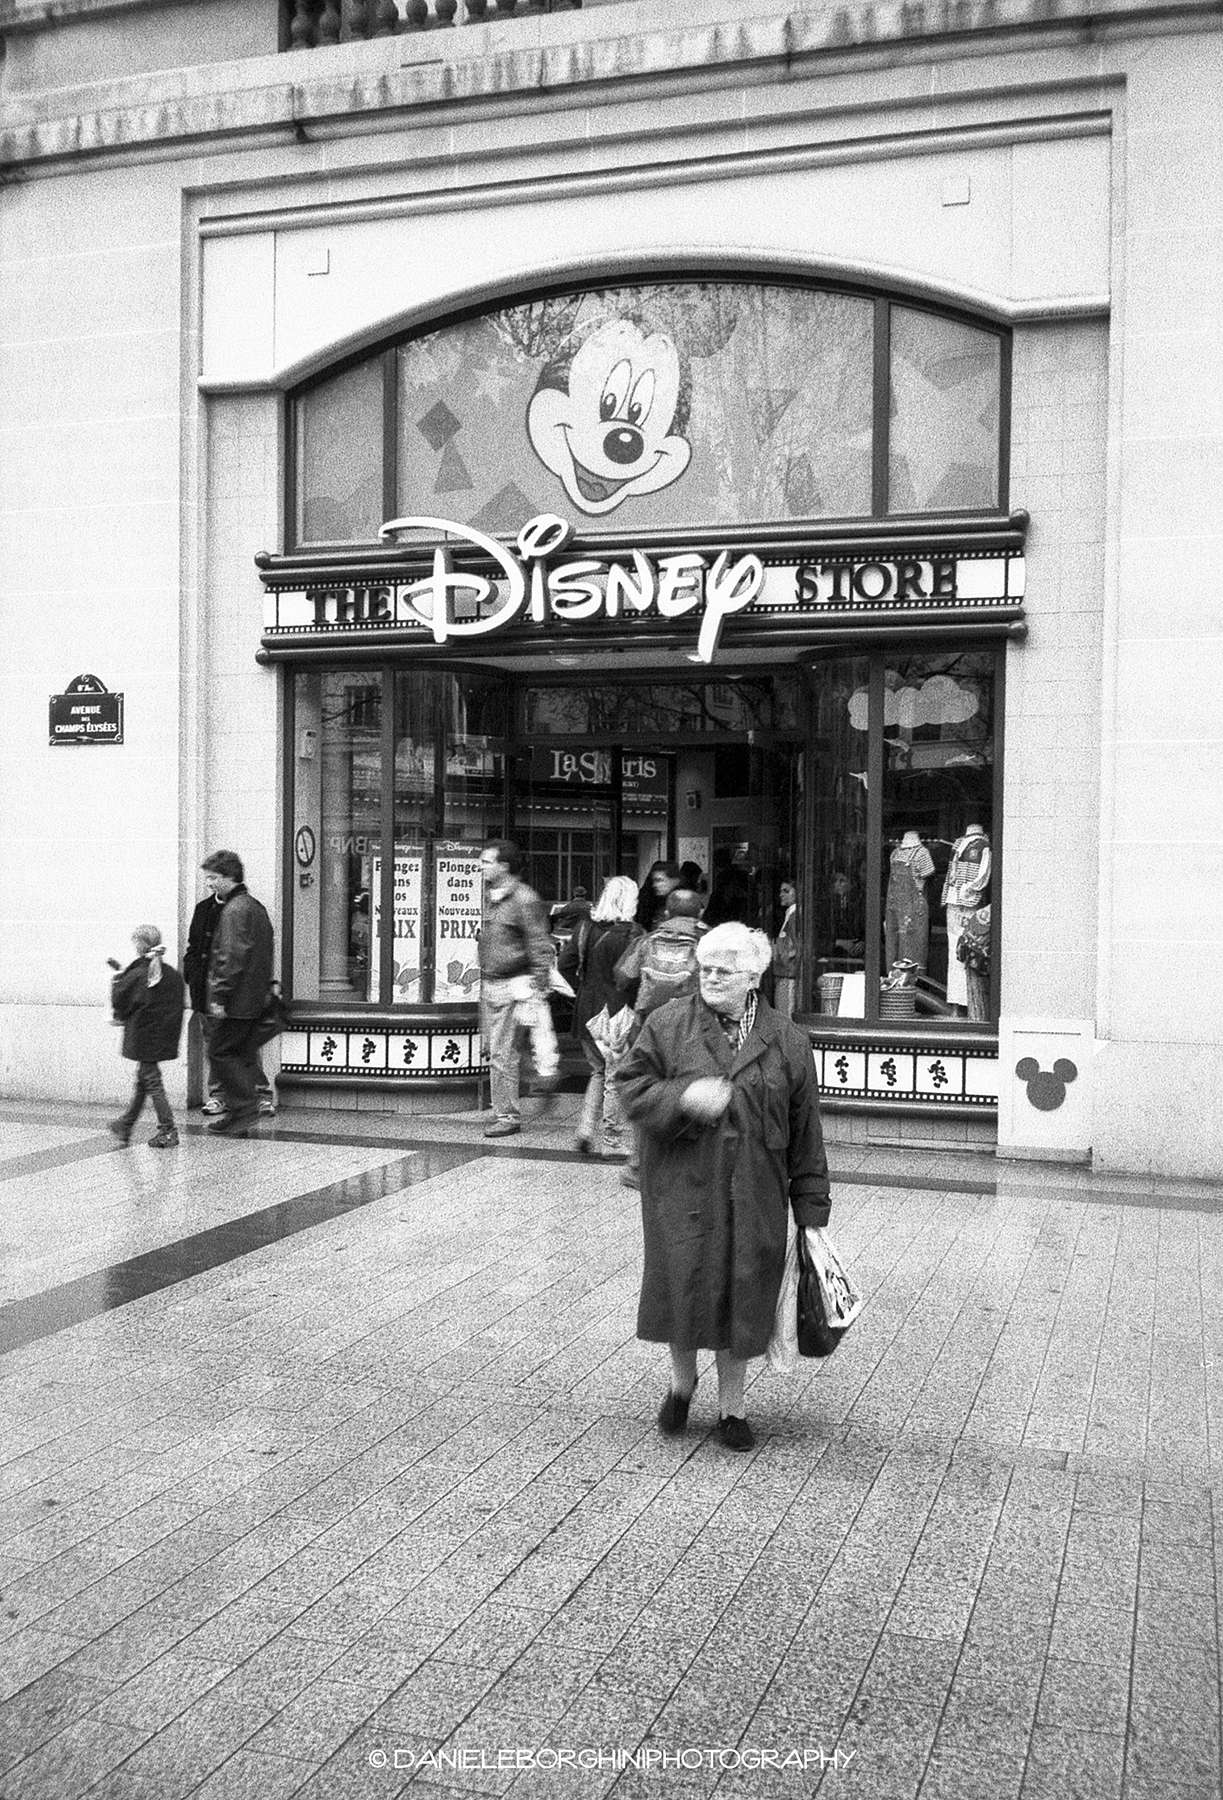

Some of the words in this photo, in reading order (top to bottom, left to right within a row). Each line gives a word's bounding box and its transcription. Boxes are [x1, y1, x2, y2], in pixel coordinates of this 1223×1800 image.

[305, 586, 393, 625] THE
[795, 559, 958, 602] STORE
[70, 705, 101, 715] AVENUE
[55, 723, 85, 733] CHAMPS
[439, 861, 482, 875] Plongez
[447, 877, 474, 888] dans
[450, 892, 470, 902] nos
[438, 906, 482, 916] Nouveaux
[440, 919, 479, 939] PRIX
